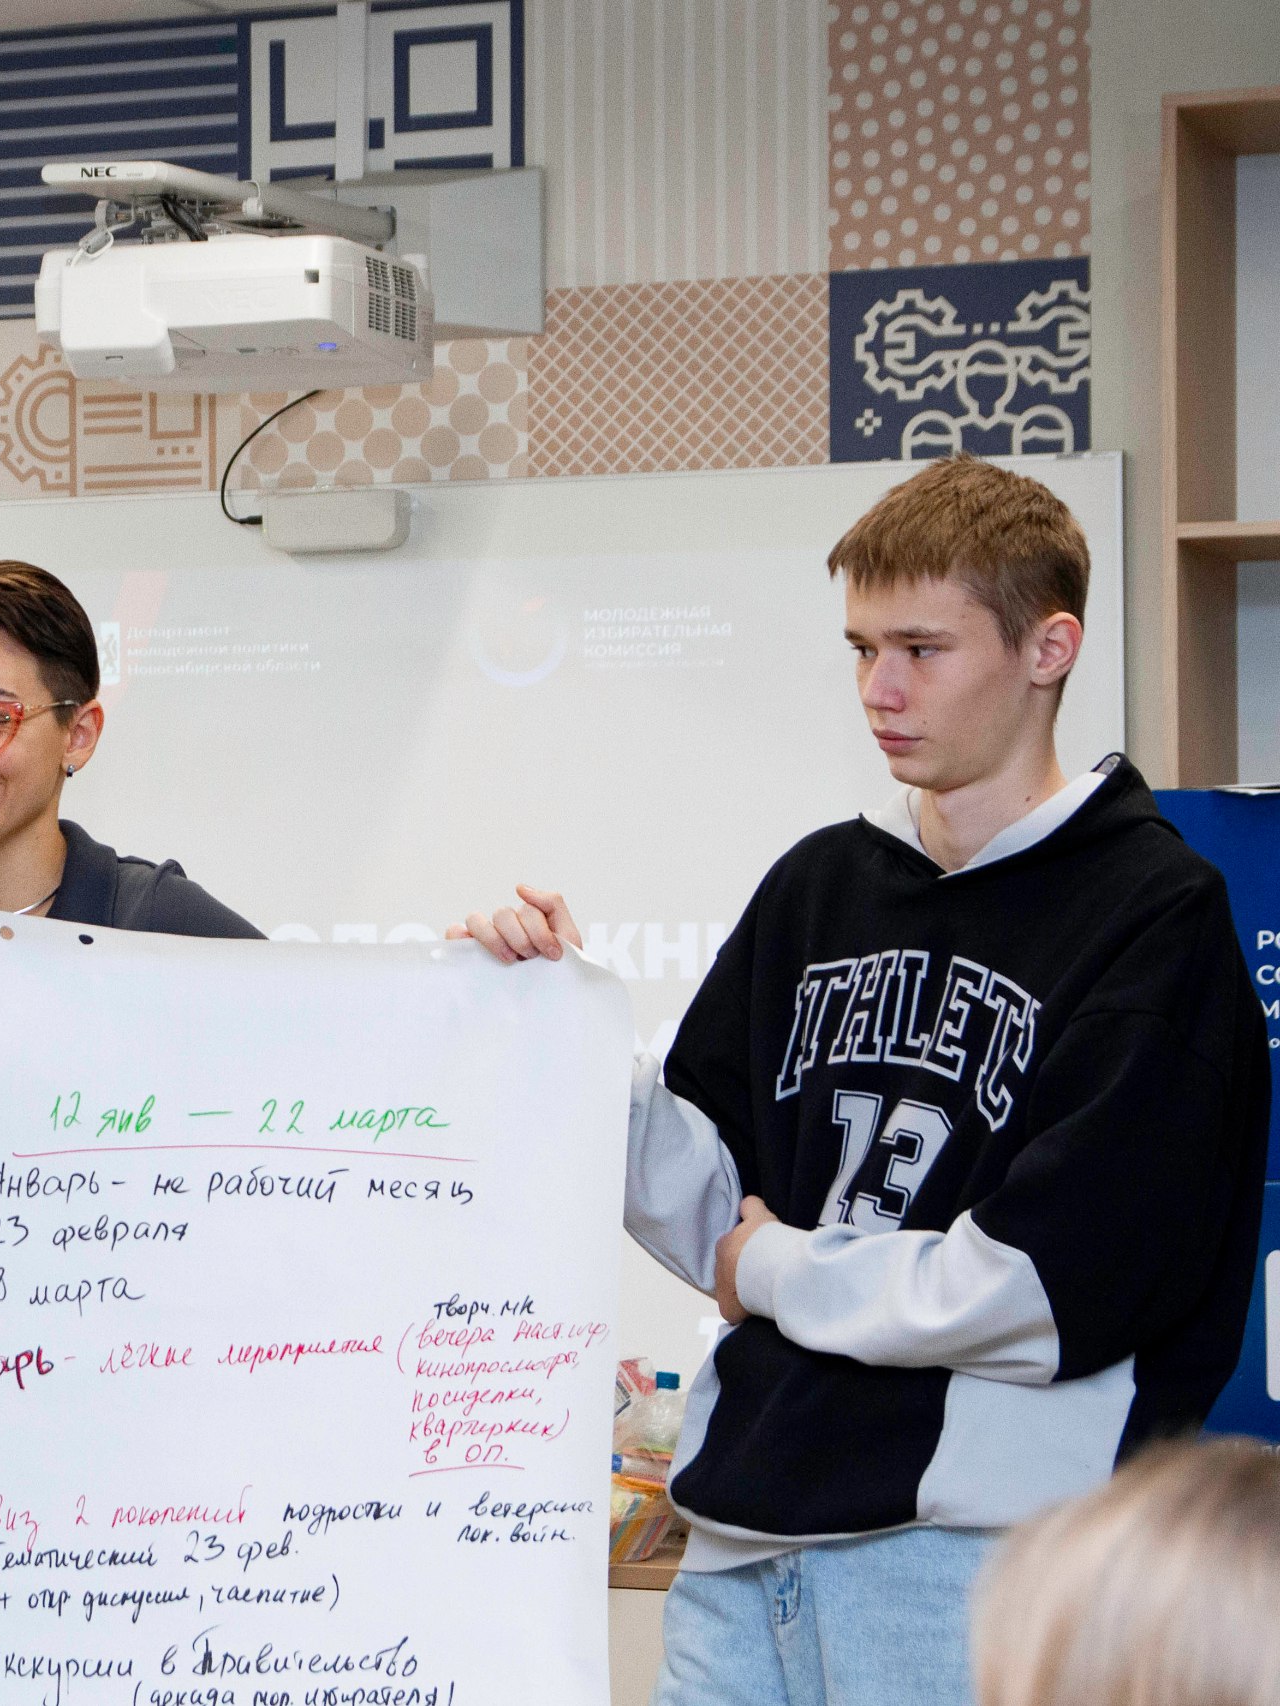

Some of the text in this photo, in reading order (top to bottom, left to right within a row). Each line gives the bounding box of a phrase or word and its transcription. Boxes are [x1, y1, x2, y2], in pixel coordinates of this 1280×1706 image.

[80, 166, 117, 178] NEC
[583, 604, 711, 622] МОЛОДЕЖНАЯ
[127, 625, 230, 640] Департамент
[583, 622, 732, 640] ИЗБИРАТЕЛЬНАЯ
[583, 642, 682, 658] КОМИССИЯ
[49, 1091, 81, 1132] 12
[96, 1094, 156, 1138] янв
[258, 1099, 306, 1135] 22
[330, 1105, 451, 1143] марта
[153, 1172, 190, 1196] не
[208, 1167, 350, 1204] рабочий
[367, 1178, 475, 1204] месяц
[52, 1215, 190, 1255] февраля
[29, 1276, 146, 1313] марта
[218, 1335, 385, 1373] мероприятия
[75, 1494, 90, 1526] 2
[283, 1500, 402, 1536] подростки
[426, 1501, 442, 1518] и
[183, 1530, 226, 1562] 23
[161, 1645, 179, 1676] в
